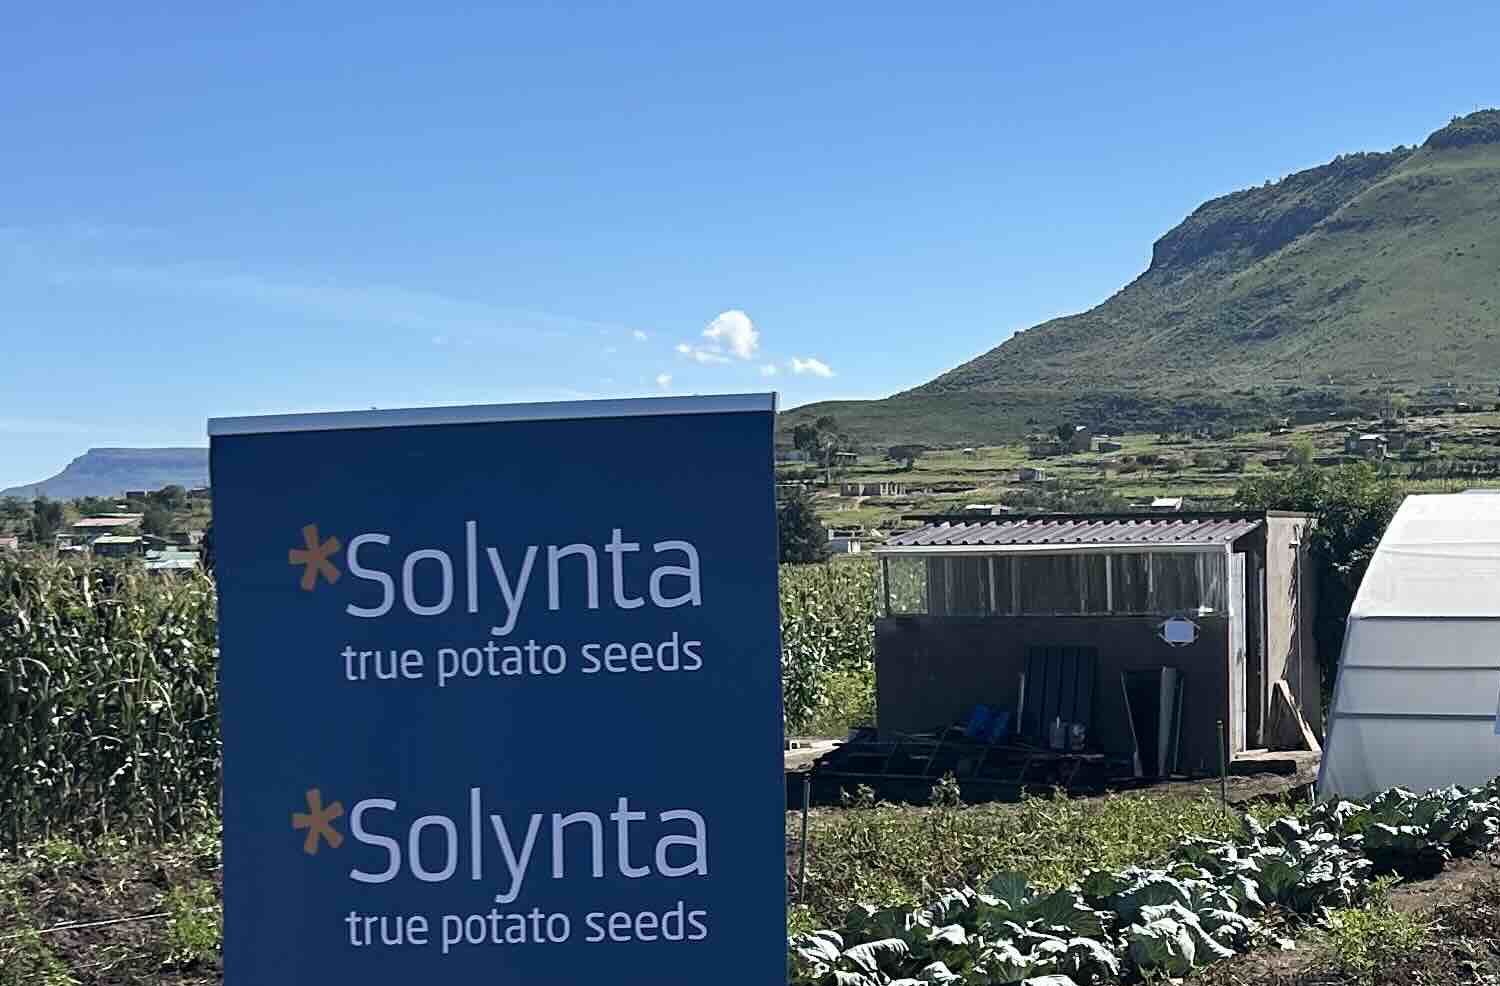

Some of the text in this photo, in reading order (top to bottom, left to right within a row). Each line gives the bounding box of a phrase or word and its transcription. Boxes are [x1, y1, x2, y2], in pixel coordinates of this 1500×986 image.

[346, 520, 702, 637] Solynta
[341, 631, 702, 688] true potato seeds
[350, 787, 708, 905] Solynta
[345, 900, 707, 954] true potato seeds
